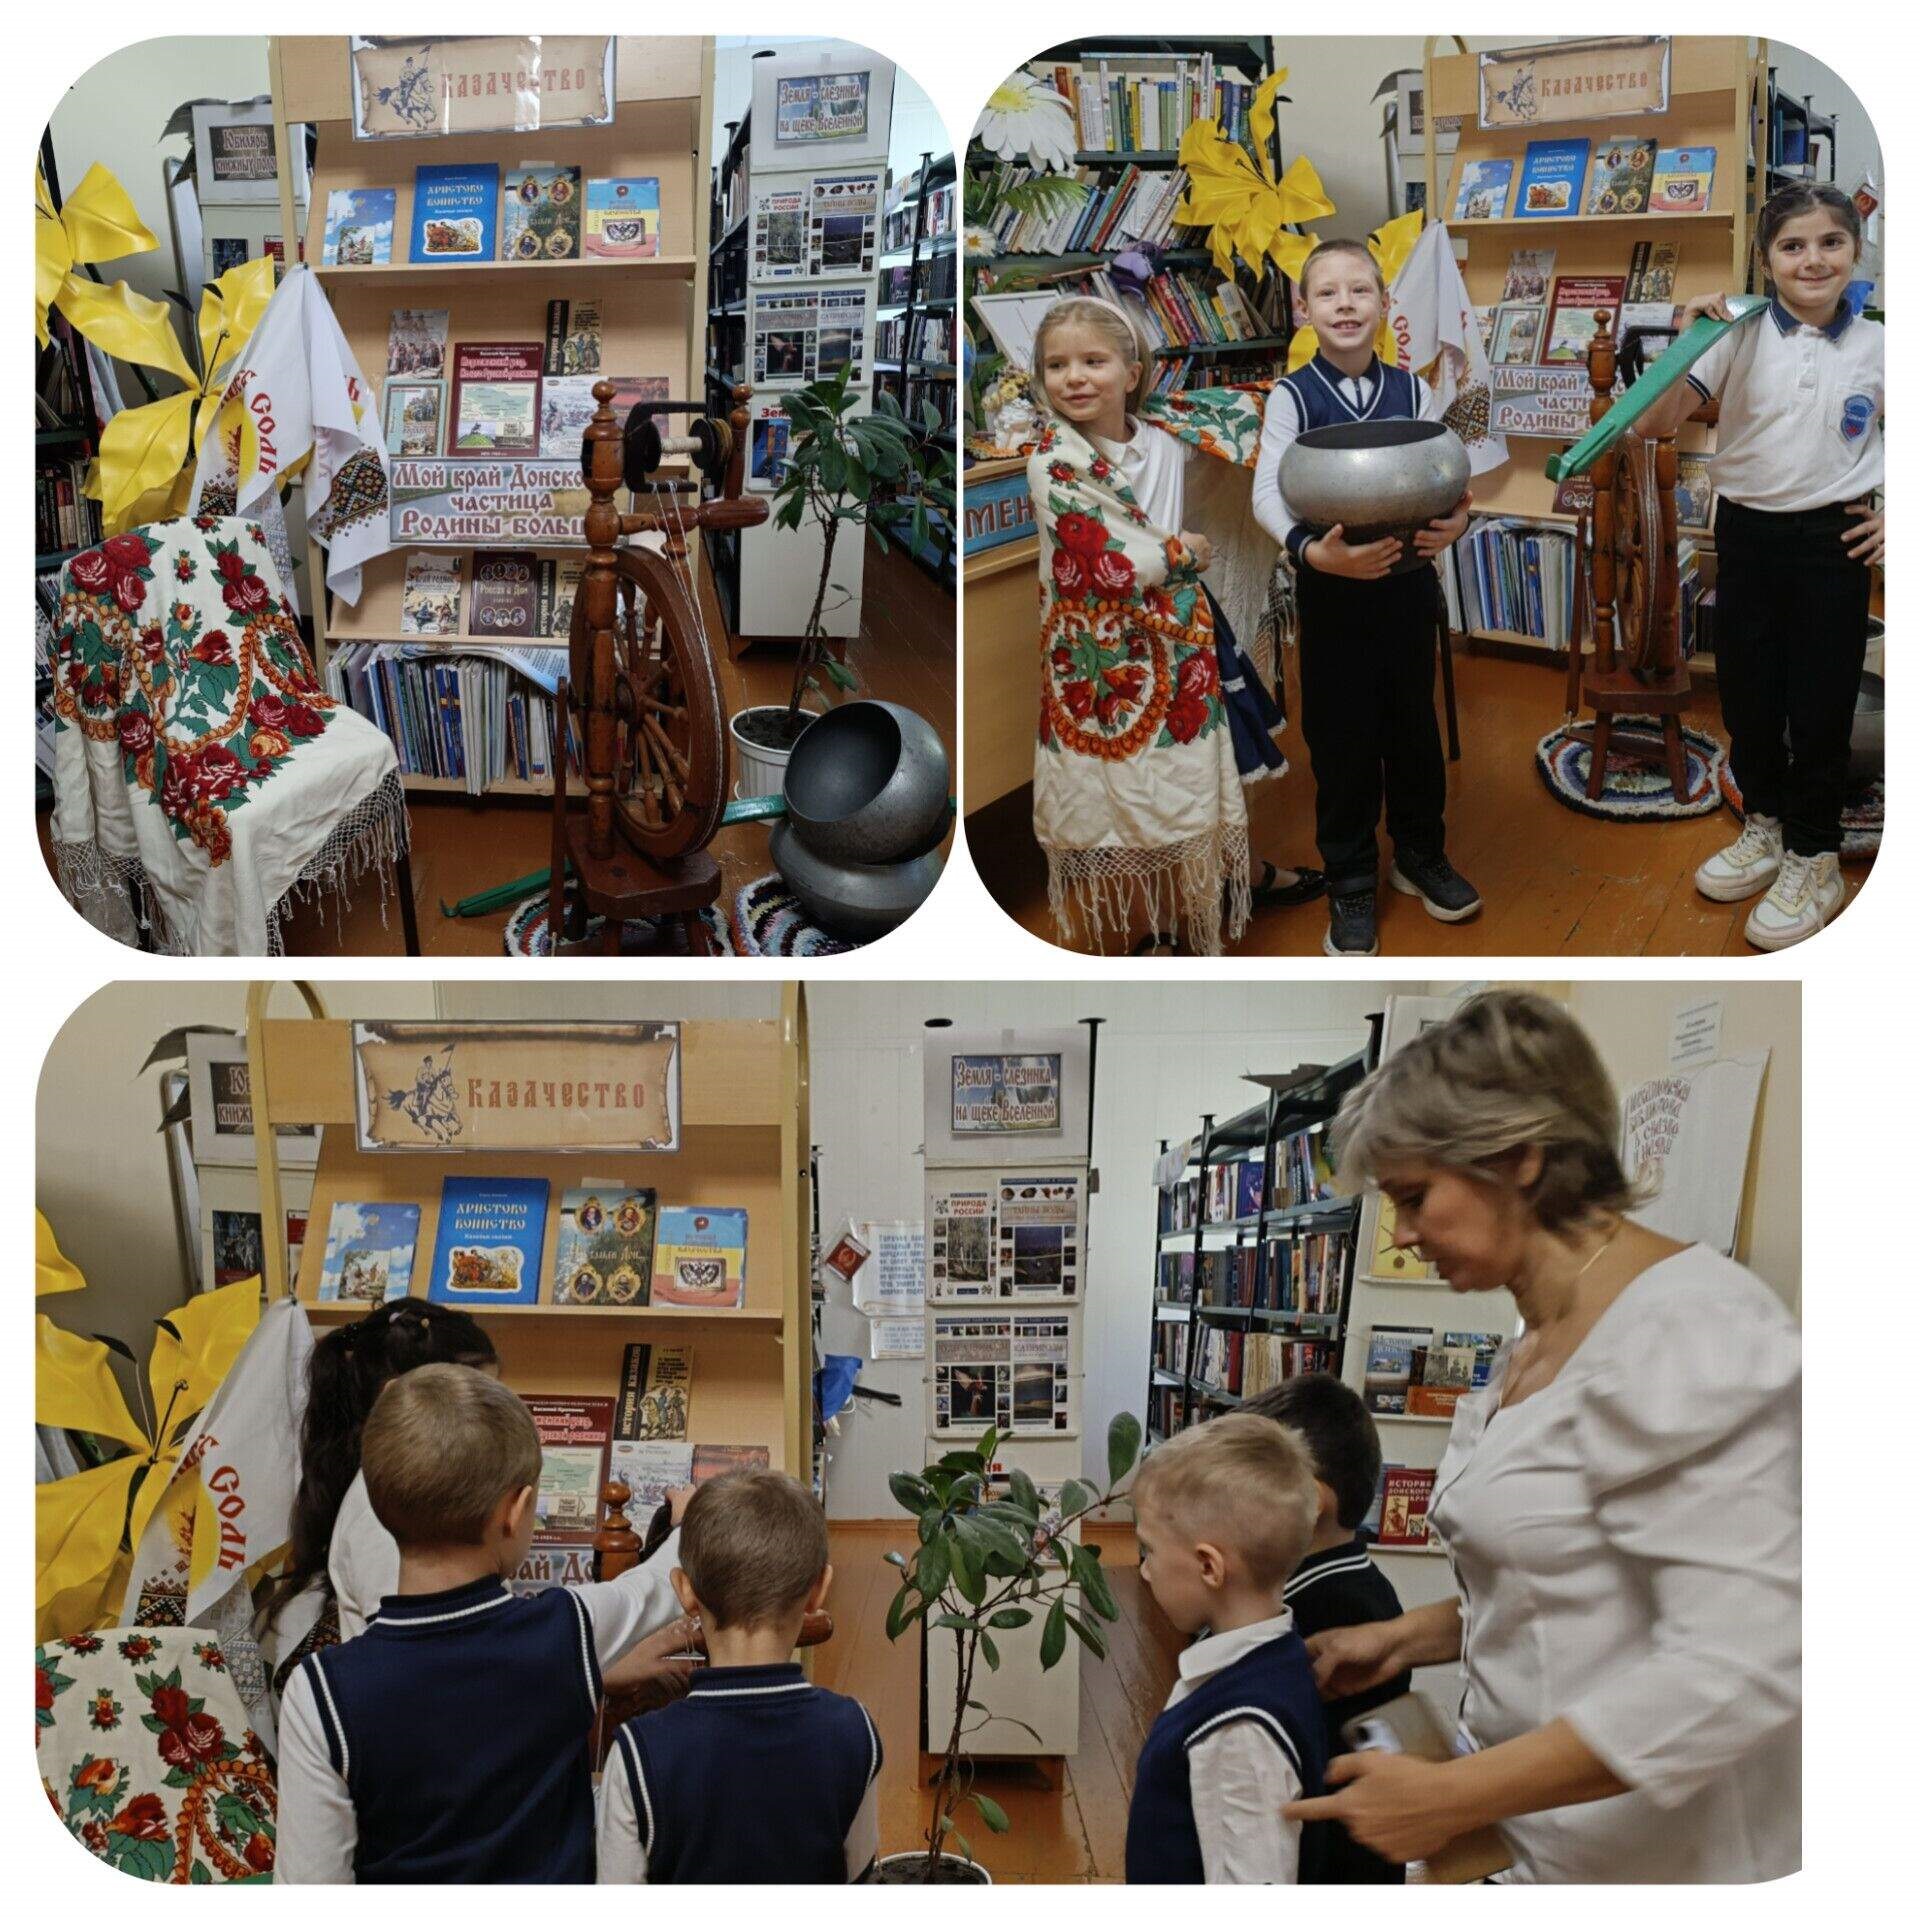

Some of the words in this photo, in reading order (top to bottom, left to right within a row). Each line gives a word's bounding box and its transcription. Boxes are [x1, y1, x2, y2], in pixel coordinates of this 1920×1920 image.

[1498, 369, 1534, 388] Мой
[1541, 374, 1577, 396] край
[1500, 407, 1576, 430] Родины
[394, 464, 445, 486] Мой
[452, 466, 502, 493] край
[449, 493, 553, 514] частица
[401, 510, 501, 538] Родины
[957, 1061, 992, 1088] Земля
